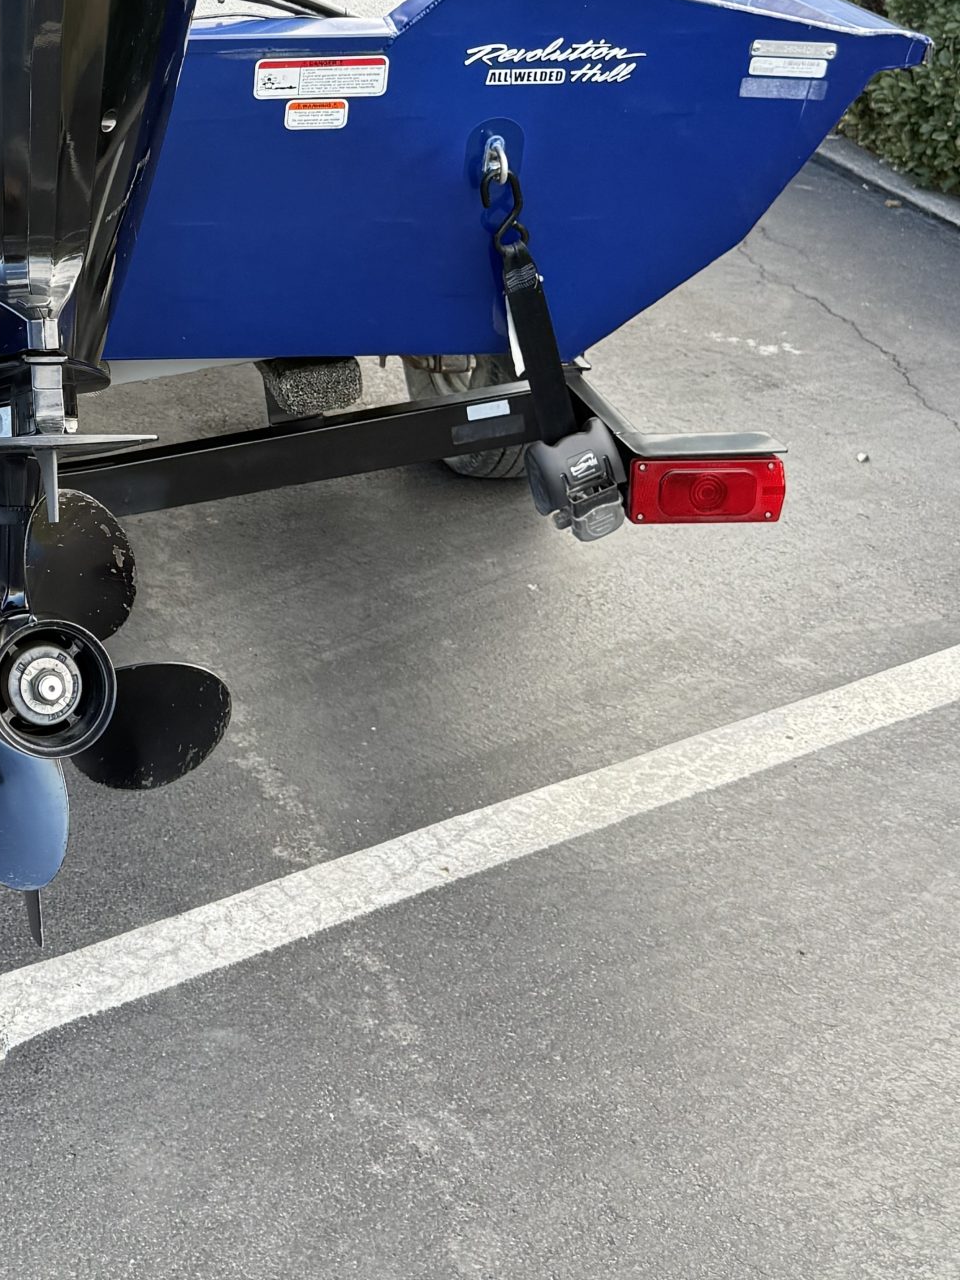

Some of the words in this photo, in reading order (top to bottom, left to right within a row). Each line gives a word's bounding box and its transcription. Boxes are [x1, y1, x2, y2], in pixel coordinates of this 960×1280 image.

[464, 38, 646, 66] Revolution
[487, 71, 511, 84] ALL
[513, 70, 564, 83] WELDED
[570, 63, 637, 84] Hull
